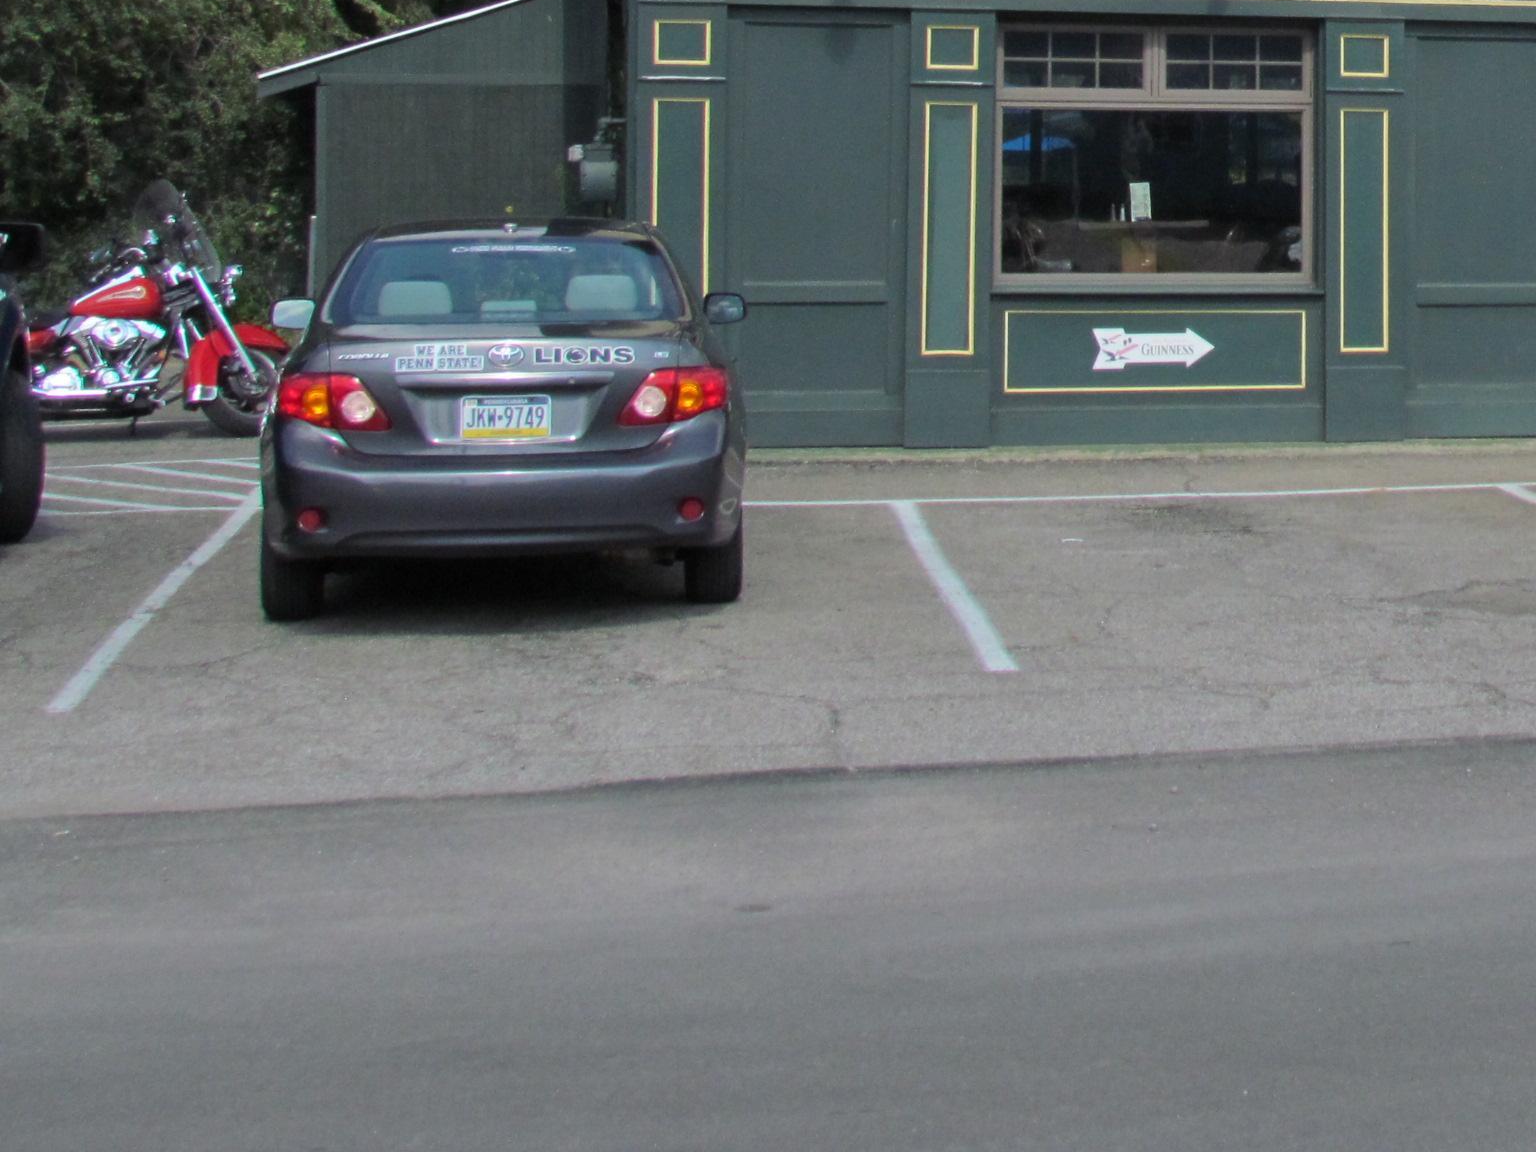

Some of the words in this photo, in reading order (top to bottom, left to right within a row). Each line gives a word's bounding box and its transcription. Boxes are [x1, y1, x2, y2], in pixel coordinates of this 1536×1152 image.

[416, 345, 434, 356] WE
[440, 345, 465, 356] ARE
[399, 358, 433, 369] PENN
